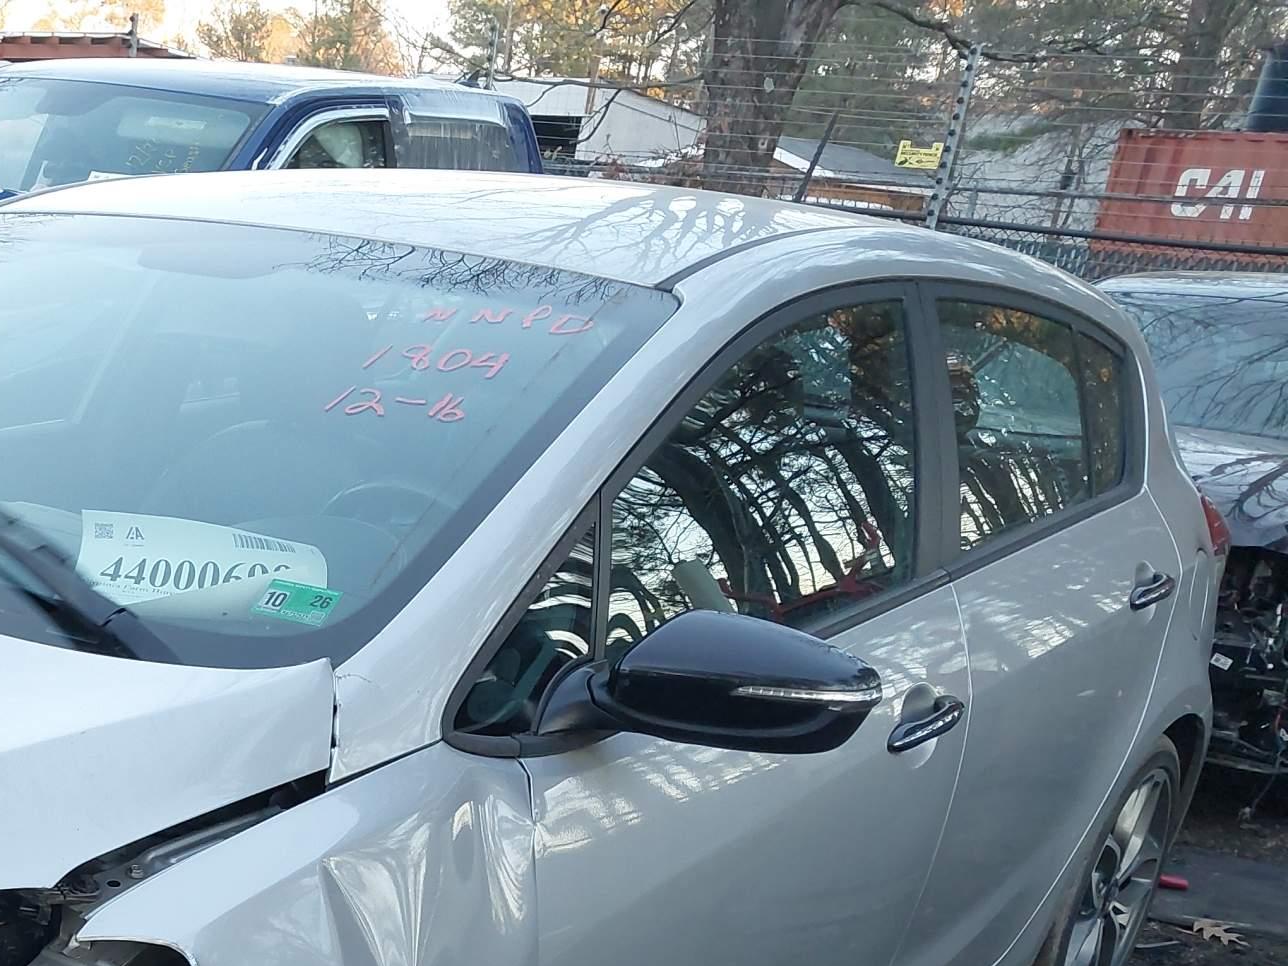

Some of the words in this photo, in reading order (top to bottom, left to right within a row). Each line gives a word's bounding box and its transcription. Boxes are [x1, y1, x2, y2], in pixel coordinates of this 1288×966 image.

[363, 344, 510, 379] 1804
[324, 385, 465, 422] 12-16
[99, 556, 292, 590] 440006
[264, 591, 288, 608] 10
[310, 595, 333, 609] 26
